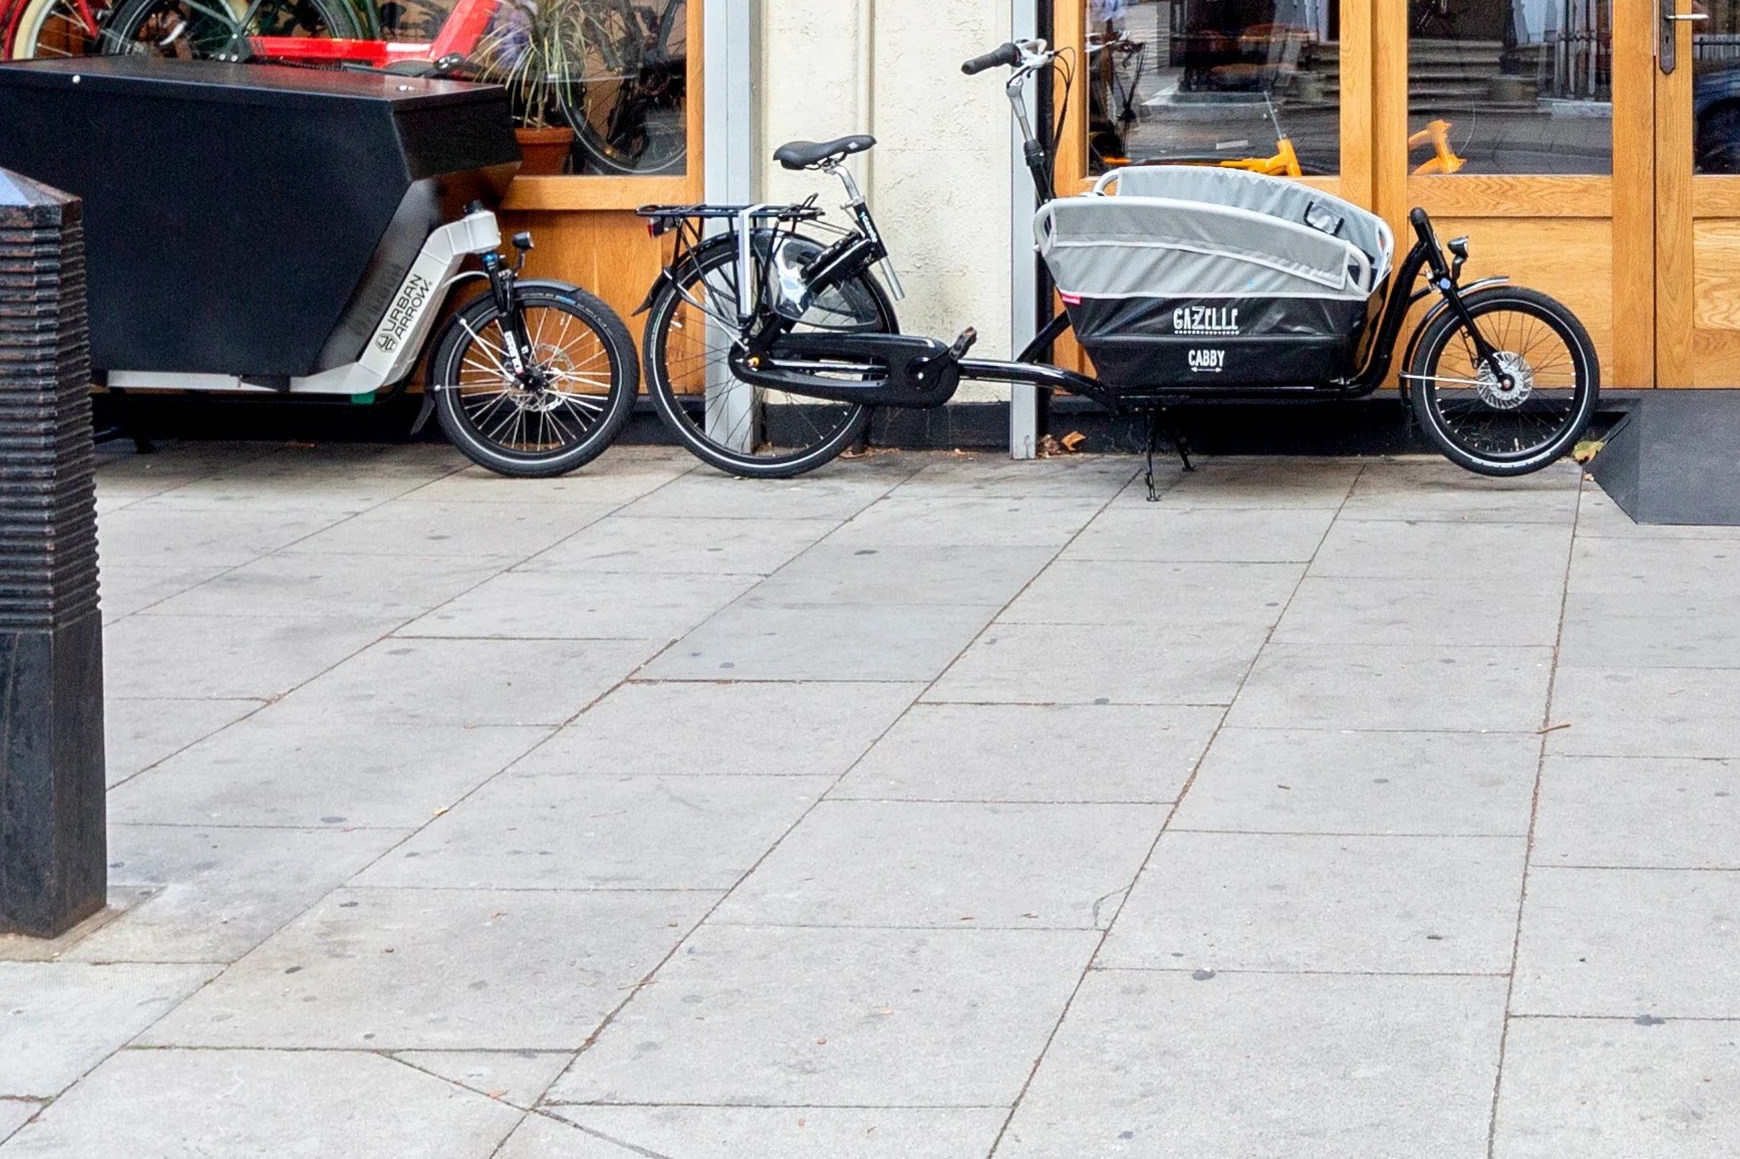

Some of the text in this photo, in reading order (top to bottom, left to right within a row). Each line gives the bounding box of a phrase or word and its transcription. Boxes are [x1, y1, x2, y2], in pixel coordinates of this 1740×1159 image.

[382, 273, 423, 333] URBAN
[1172, 305, 1239, 330] GAZELLE
[1188, 349, 1226, 367] CABBY
